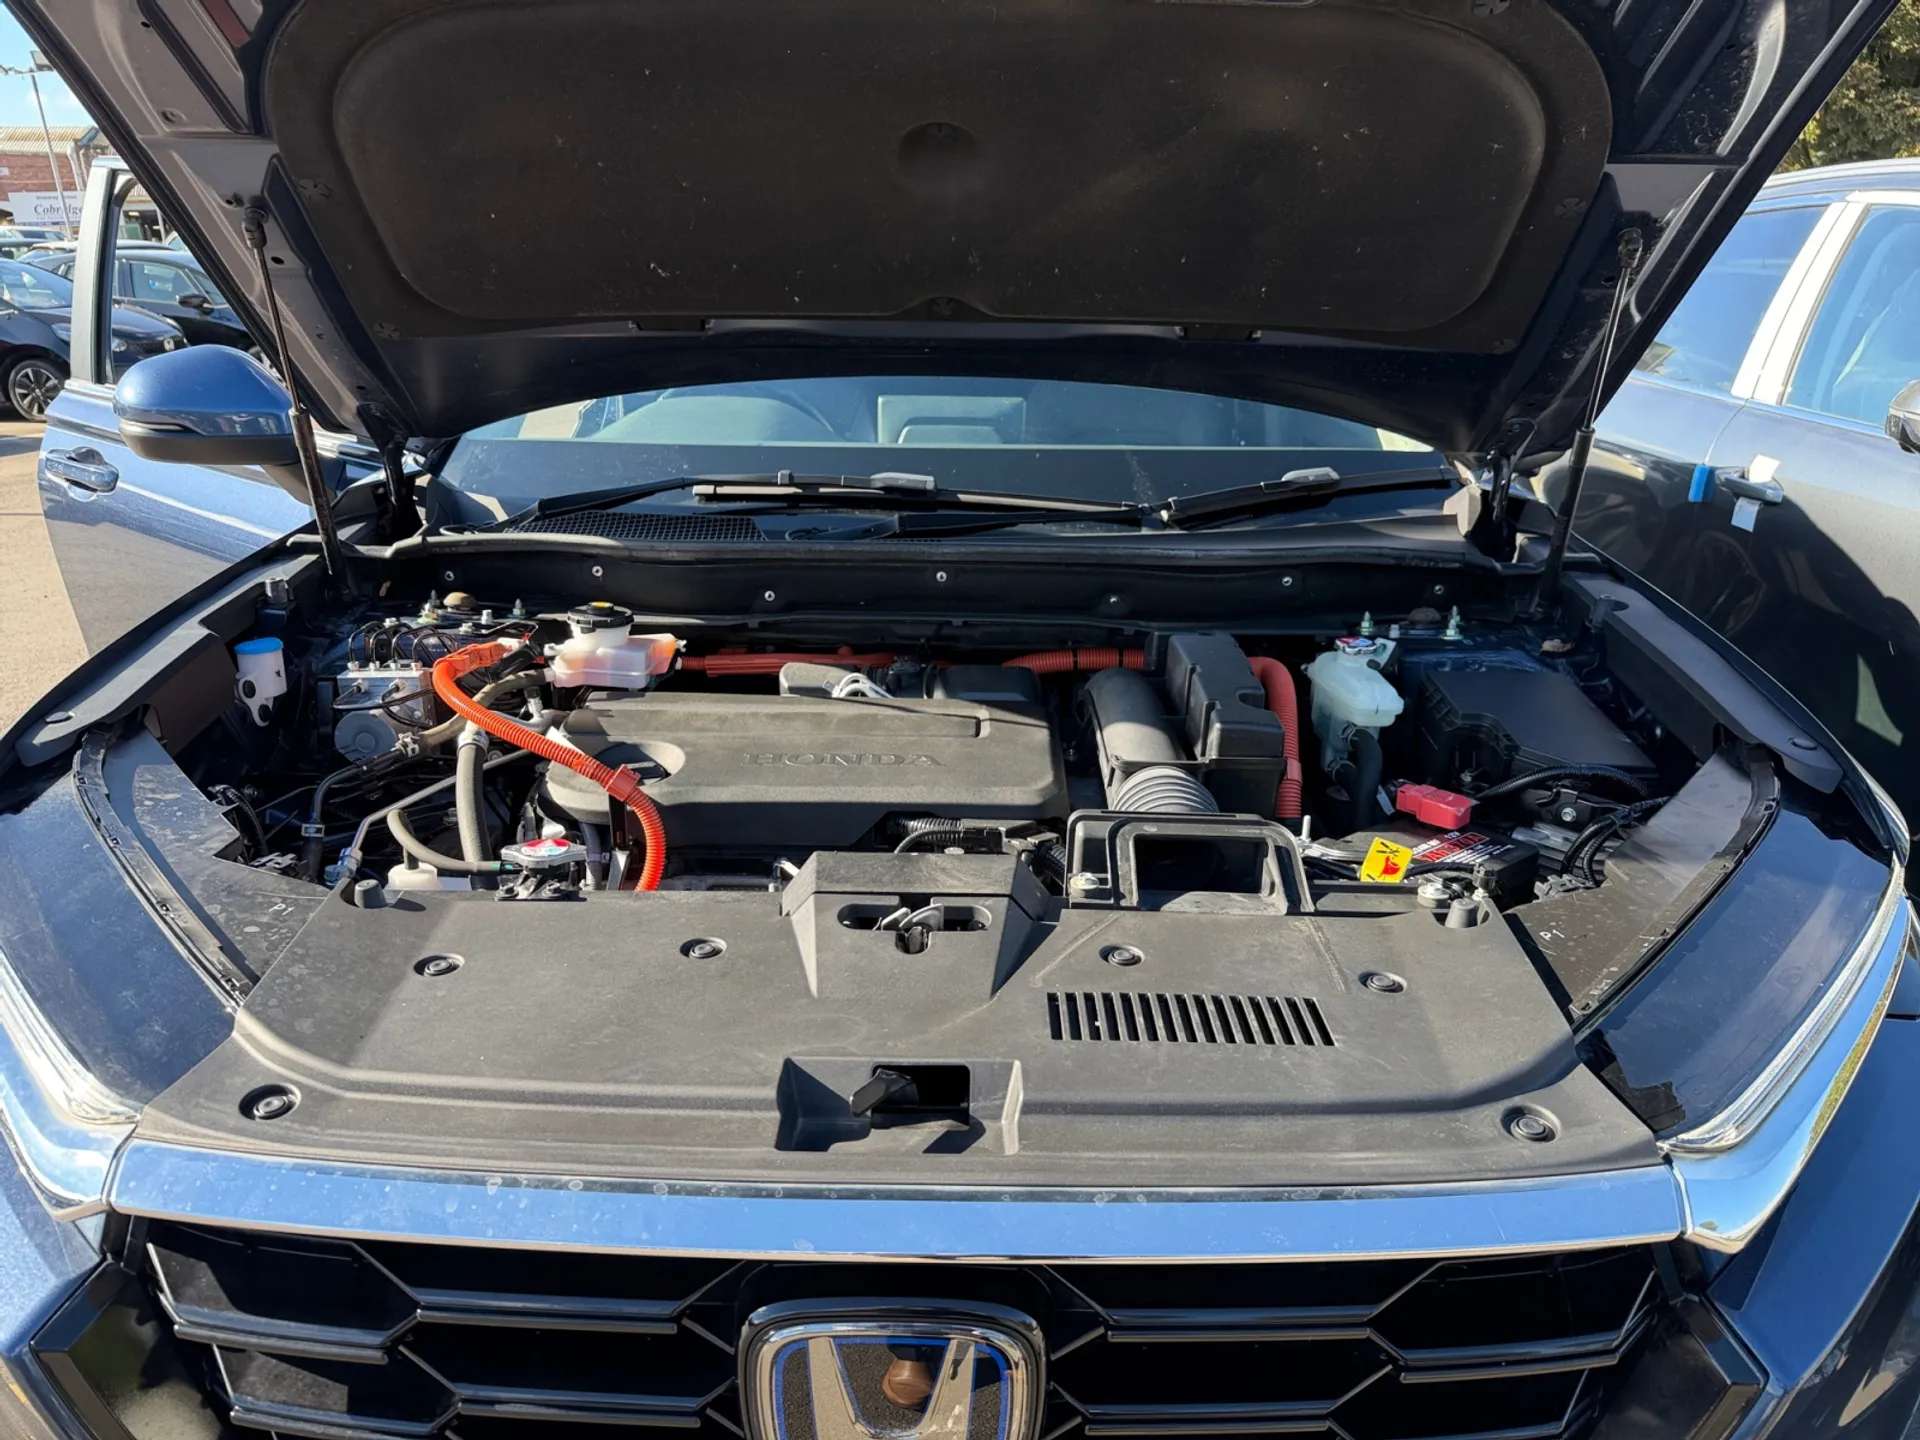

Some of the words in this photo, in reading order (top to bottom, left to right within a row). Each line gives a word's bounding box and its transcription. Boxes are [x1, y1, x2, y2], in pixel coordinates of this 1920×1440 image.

[743, 753, 947, 767] HONDA
[268, 903, 296, 915] P1
[1539, 930, 1565, 940] P1
